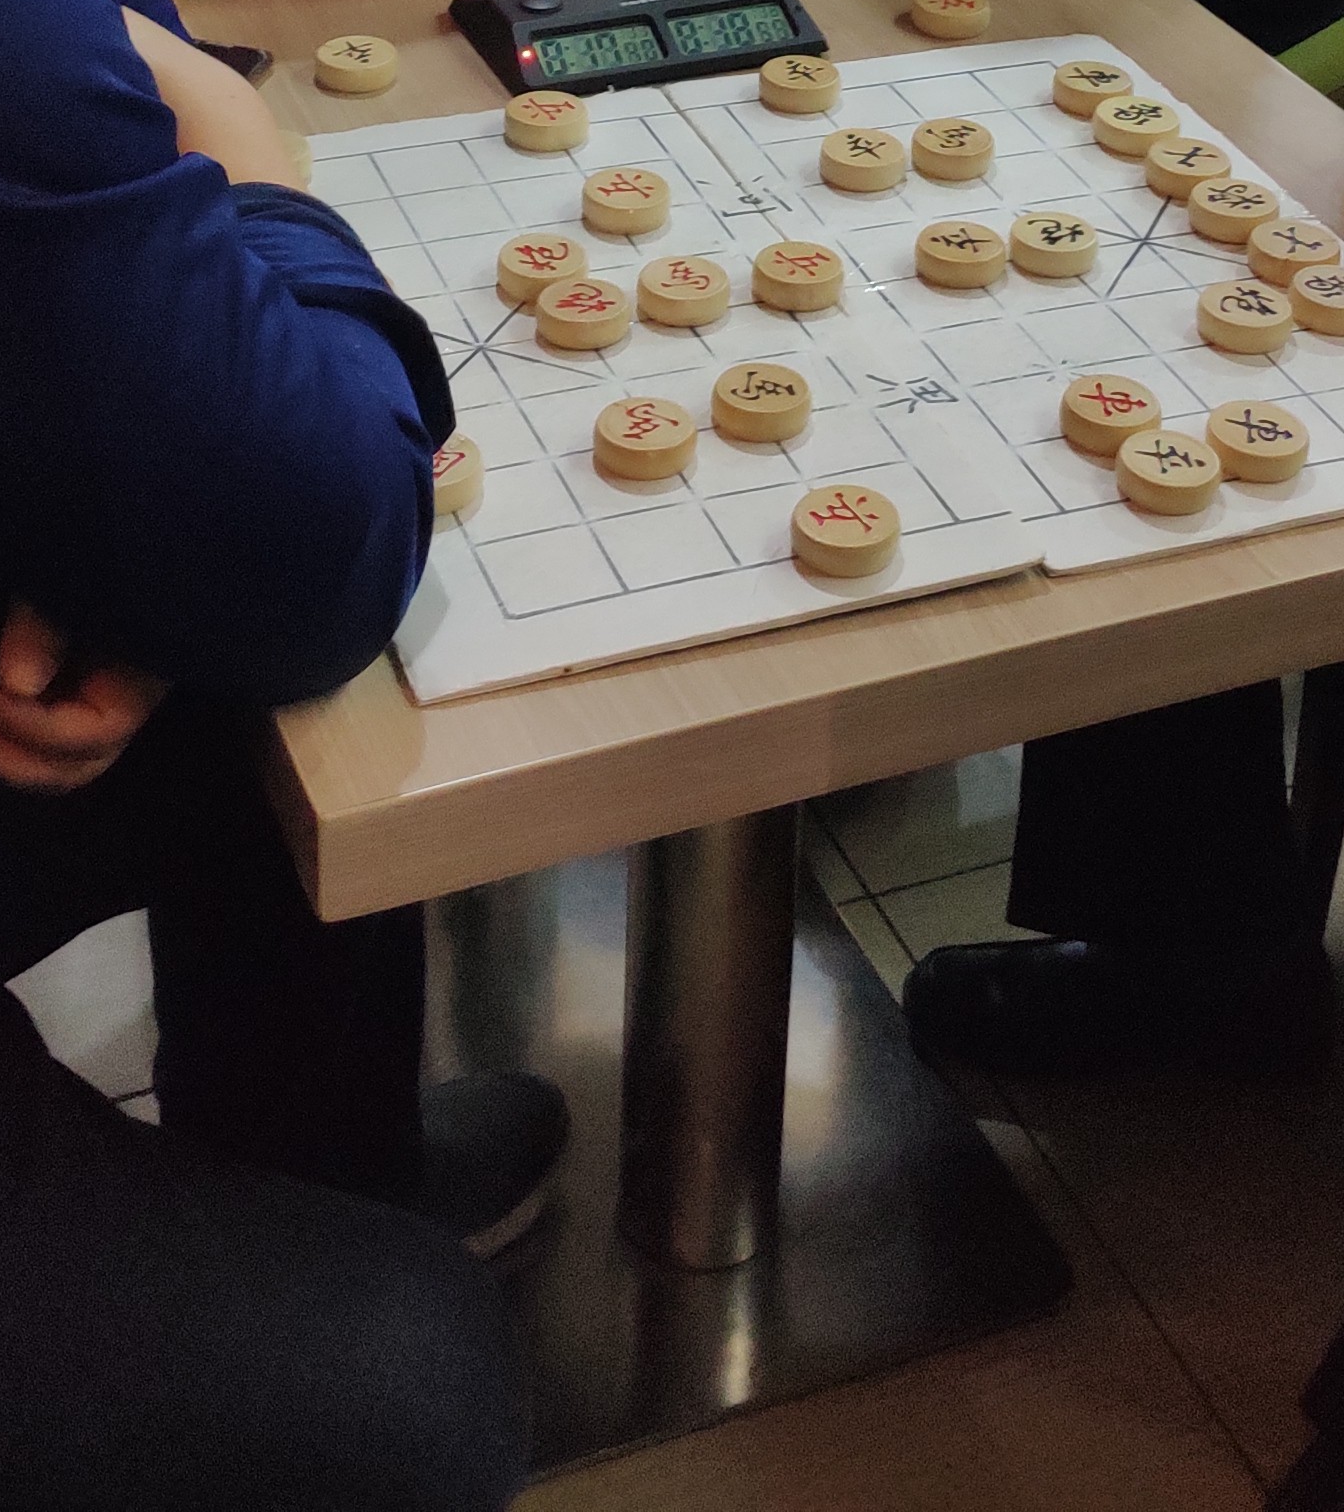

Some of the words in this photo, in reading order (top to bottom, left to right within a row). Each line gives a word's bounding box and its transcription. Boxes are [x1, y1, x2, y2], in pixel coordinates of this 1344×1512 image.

[520, 97, 576, 121] 兵
[595, 173, 655, 199] 兵
[771, 250, 831, 277] 兵
